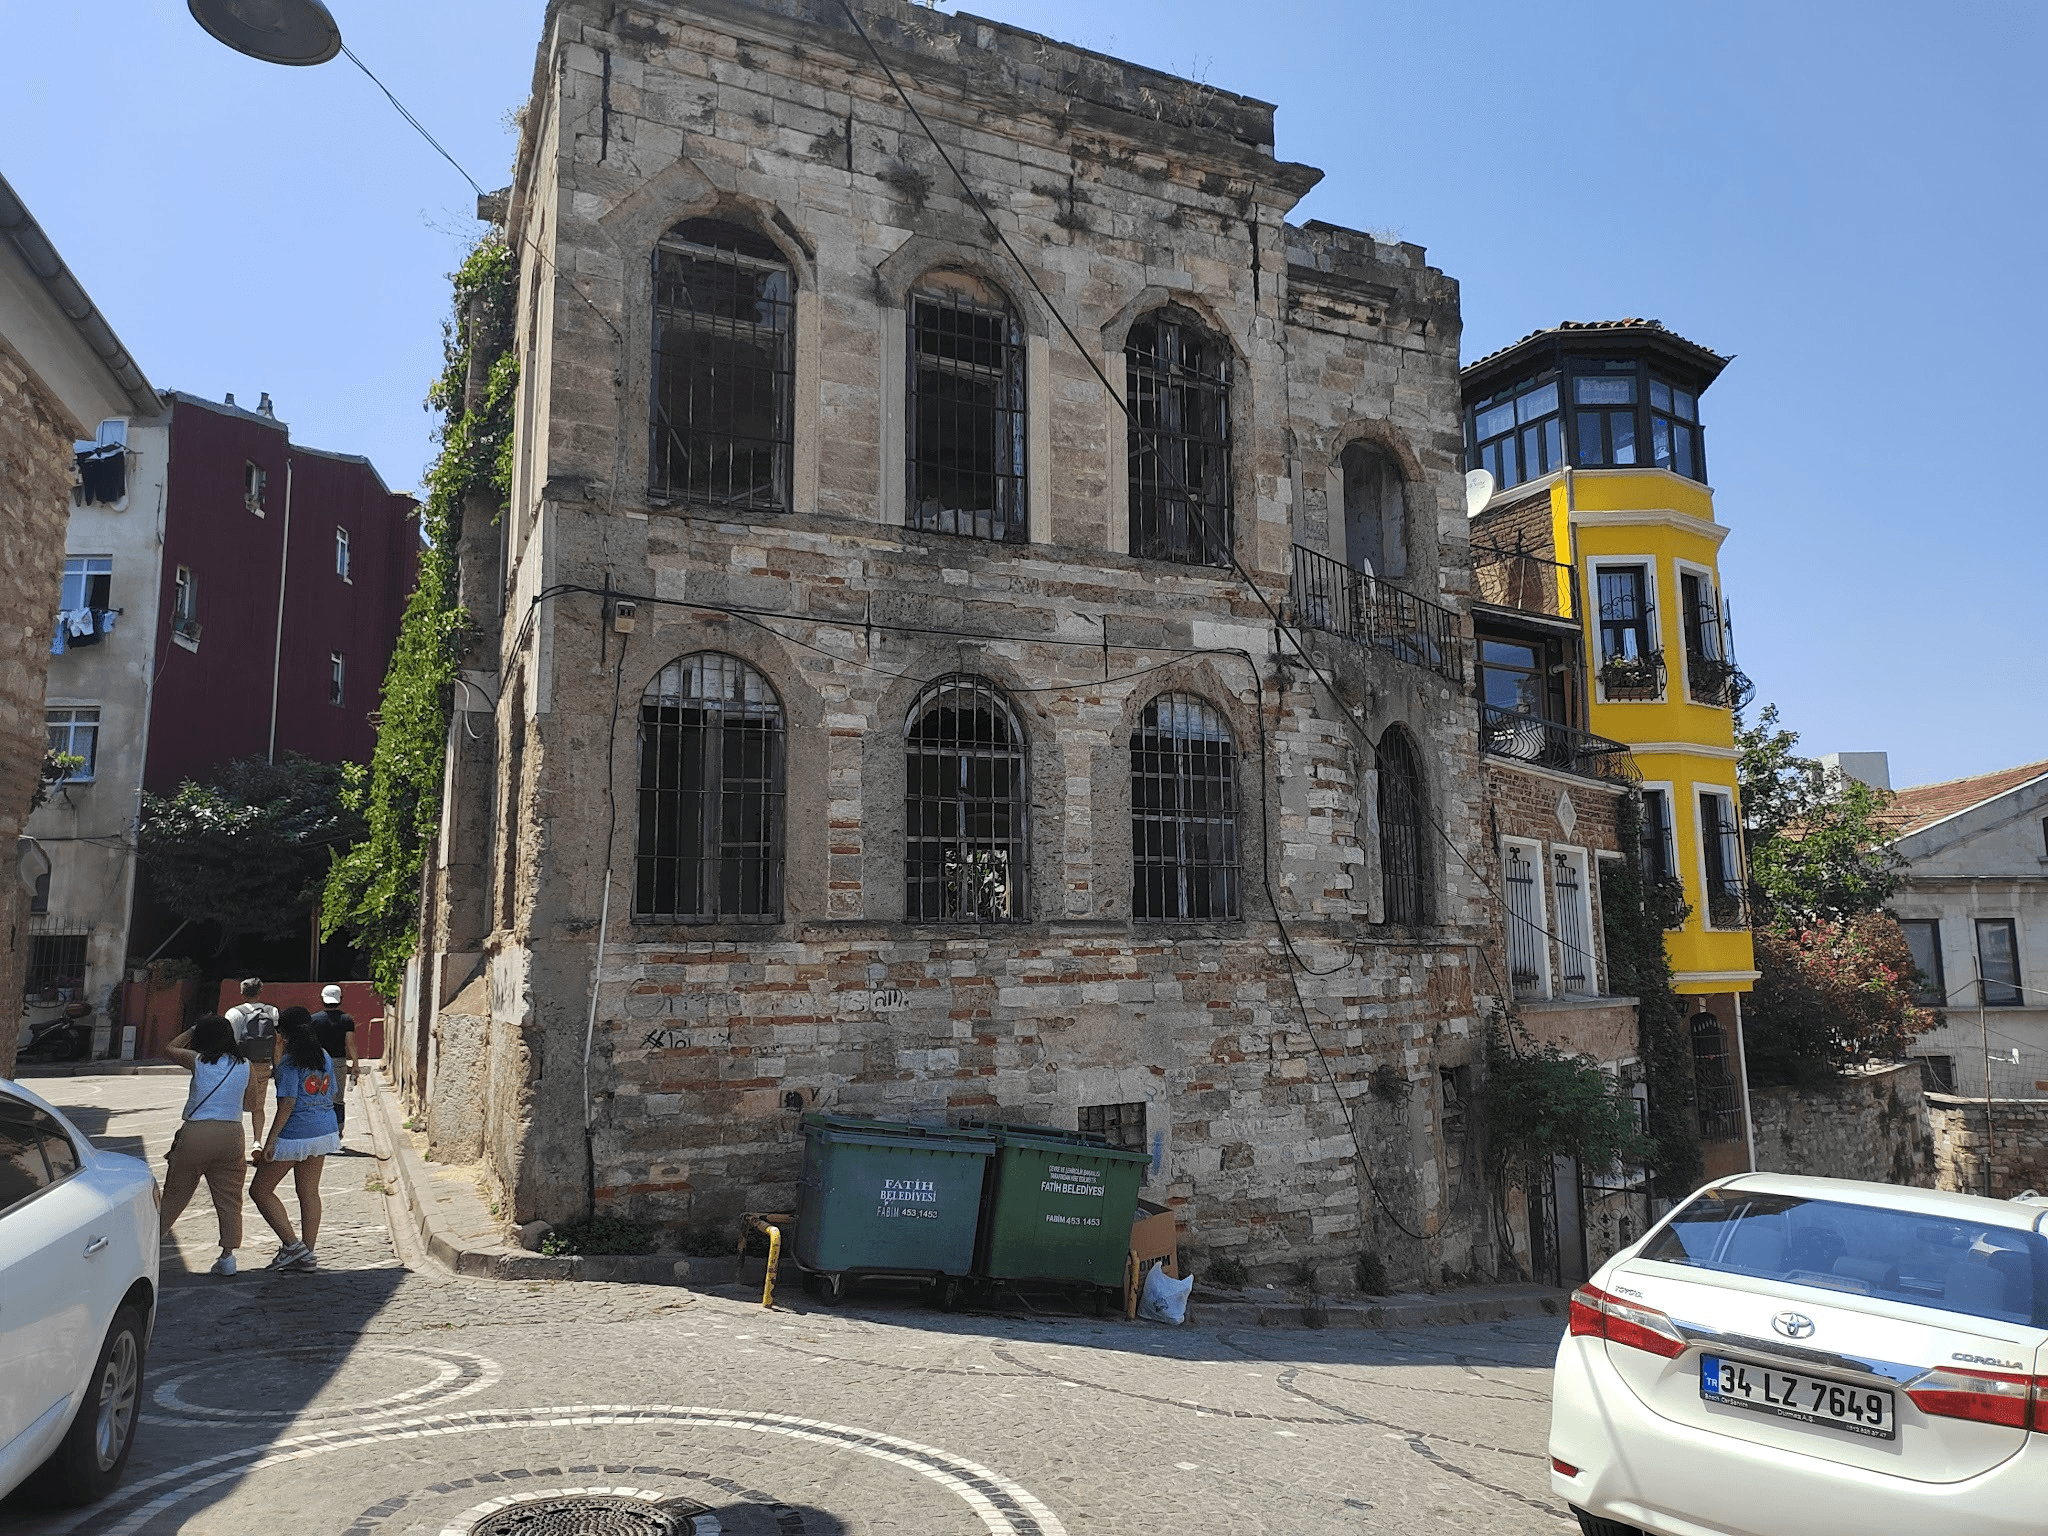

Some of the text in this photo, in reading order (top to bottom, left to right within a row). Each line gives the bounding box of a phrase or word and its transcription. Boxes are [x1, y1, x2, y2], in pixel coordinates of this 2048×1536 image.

[884, 1179, 934, 1191] FATİH
[1041, 1181, 1104, 1196] FATİH BELEDİYESİ
[880, 1190, 936, 1202] BELEDİYESİ
[901, 1208, 917, 1217] 453
[919, 1210, 938, 1219] 1453
[1066, 1216, 1081, 1225] 453
[1083, 1218, 1100, 1226] 1453
[1951, 1352, 2023, 1371] COROLLA
[1706, 1376, 1718, 1388] TR
[1720, 1364, 1882, 1424] 34 LZ 7649
